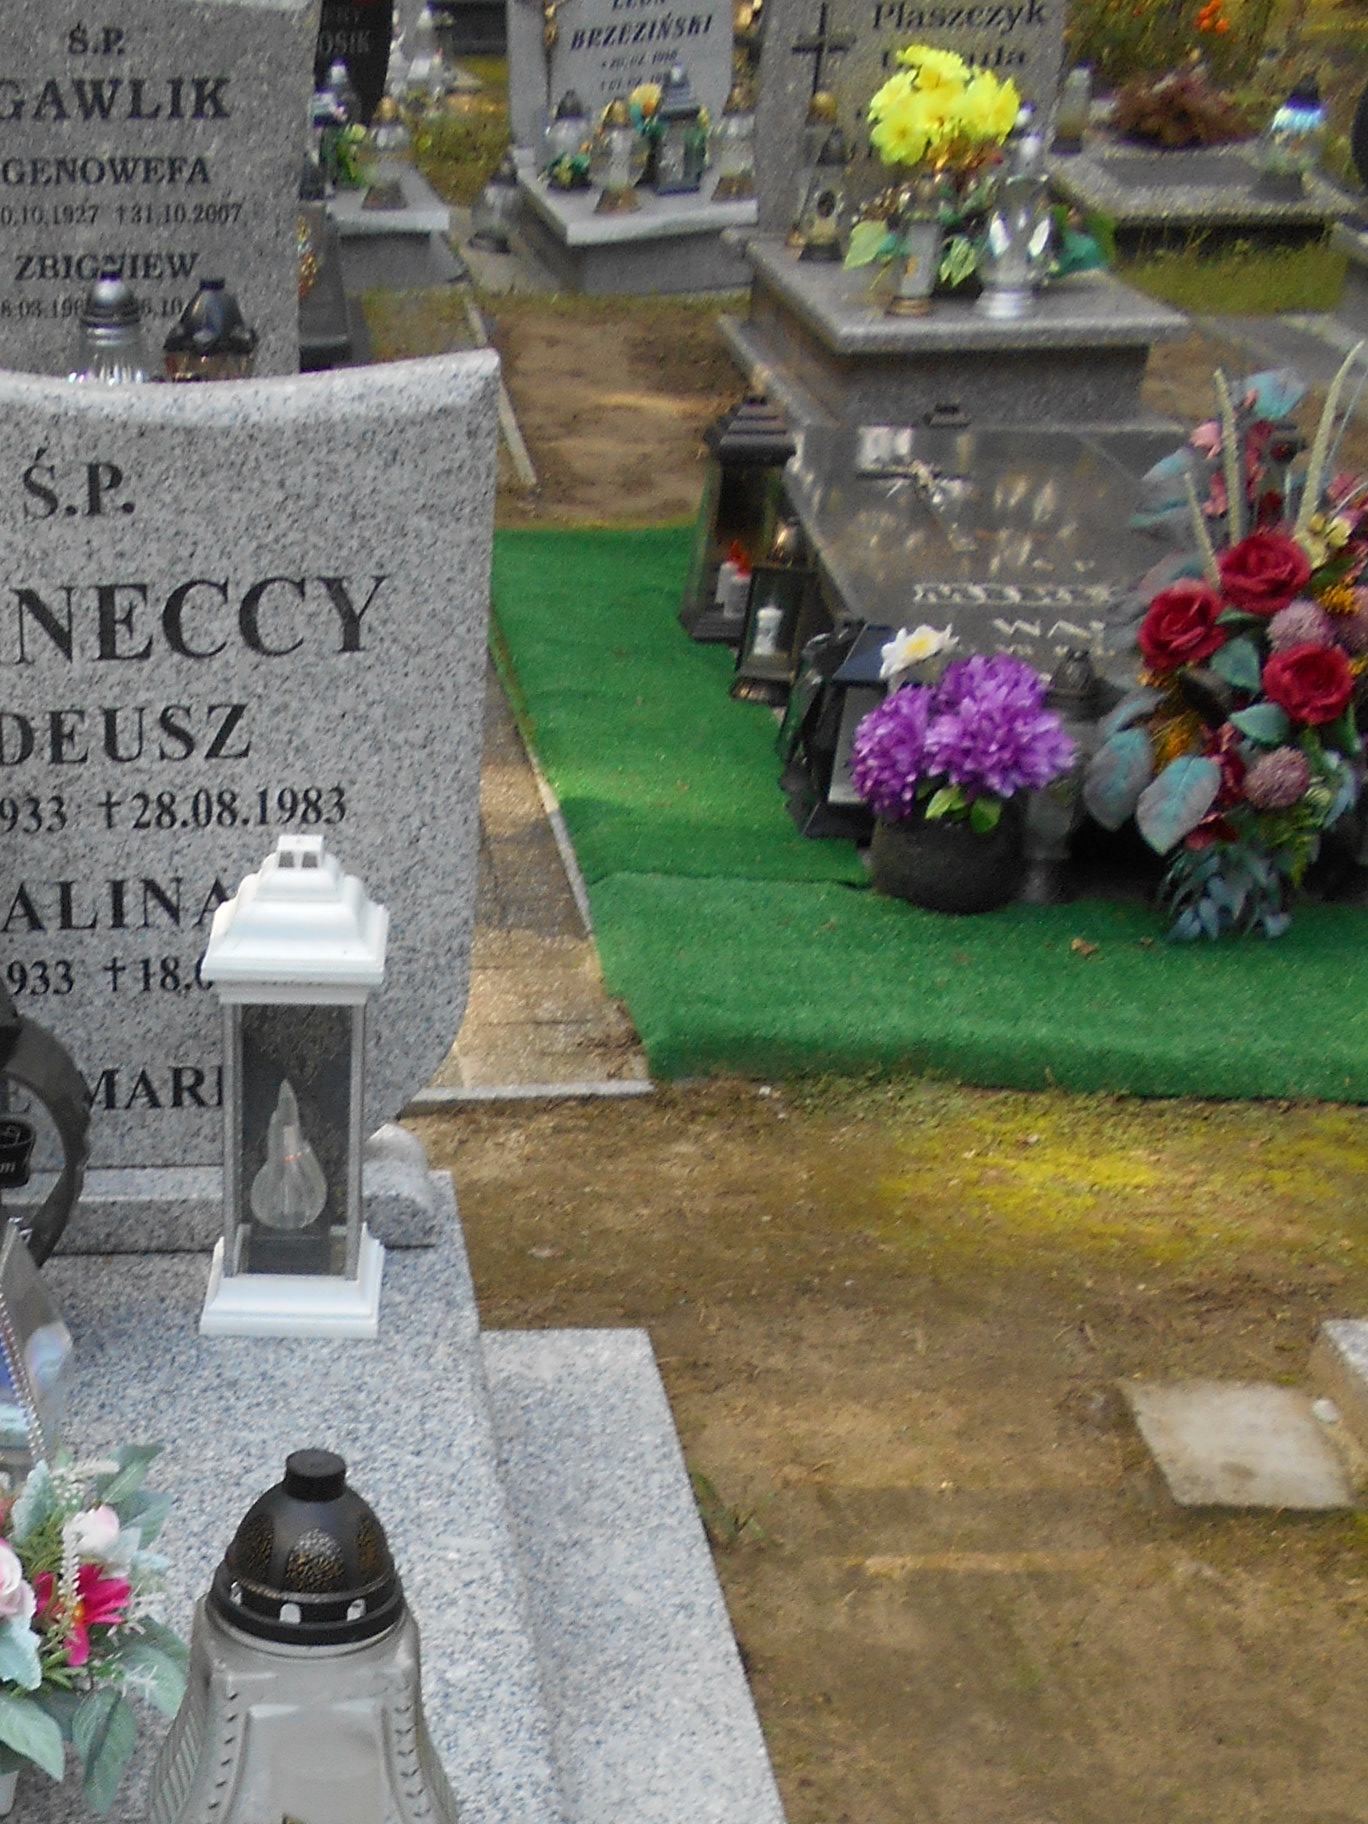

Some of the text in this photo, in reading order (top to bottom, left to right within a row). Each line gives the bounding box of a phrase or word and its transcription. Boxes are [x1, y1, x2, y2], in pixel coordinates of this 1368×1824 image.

[571, 12, 714, 50] BRZEZIŃSKI
[1, 156, 211, 187] GENOWEFA
[14, 253, 200, 281] ZBIGNIEW
[22, 447, 136, 519] Ś.P.
